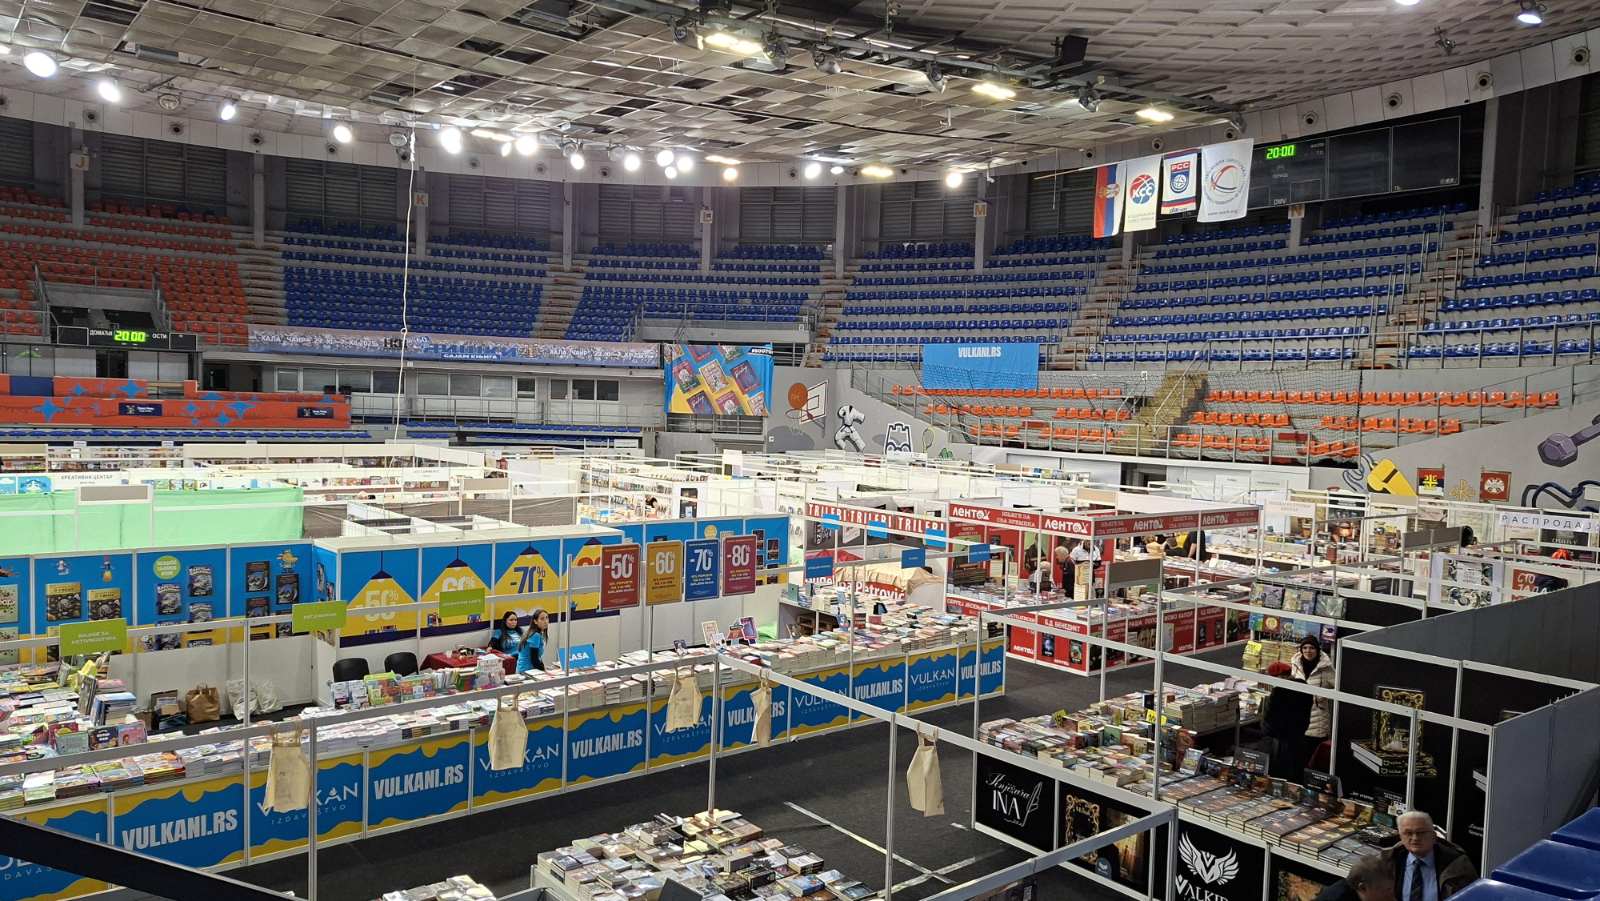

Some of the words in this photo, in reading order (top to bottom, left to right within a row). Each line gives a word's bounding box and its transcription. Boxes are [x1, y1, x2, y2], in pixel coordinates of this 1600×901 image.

[1266, 144, 1295, 159] 20:00
[958, 346, 1002, 358] VULKANI.RS
[604, 553, 635, 579] -50%
[649, 551, 676, 575] -60%
[689, 548, 714, 572] -70%
[726, 544, 751, 567] -80%
[854, 678, 904, 700] VULKANI.RS
[911, 667, 955, 687] VULKAN
[571, 728, 643, 760] VULKANI.RS
[373, 764, 465, 800] VULKANI.RS
[993, 790, 1021, 820] INA
[121, 808, 239, 852] VULKANI.RS
